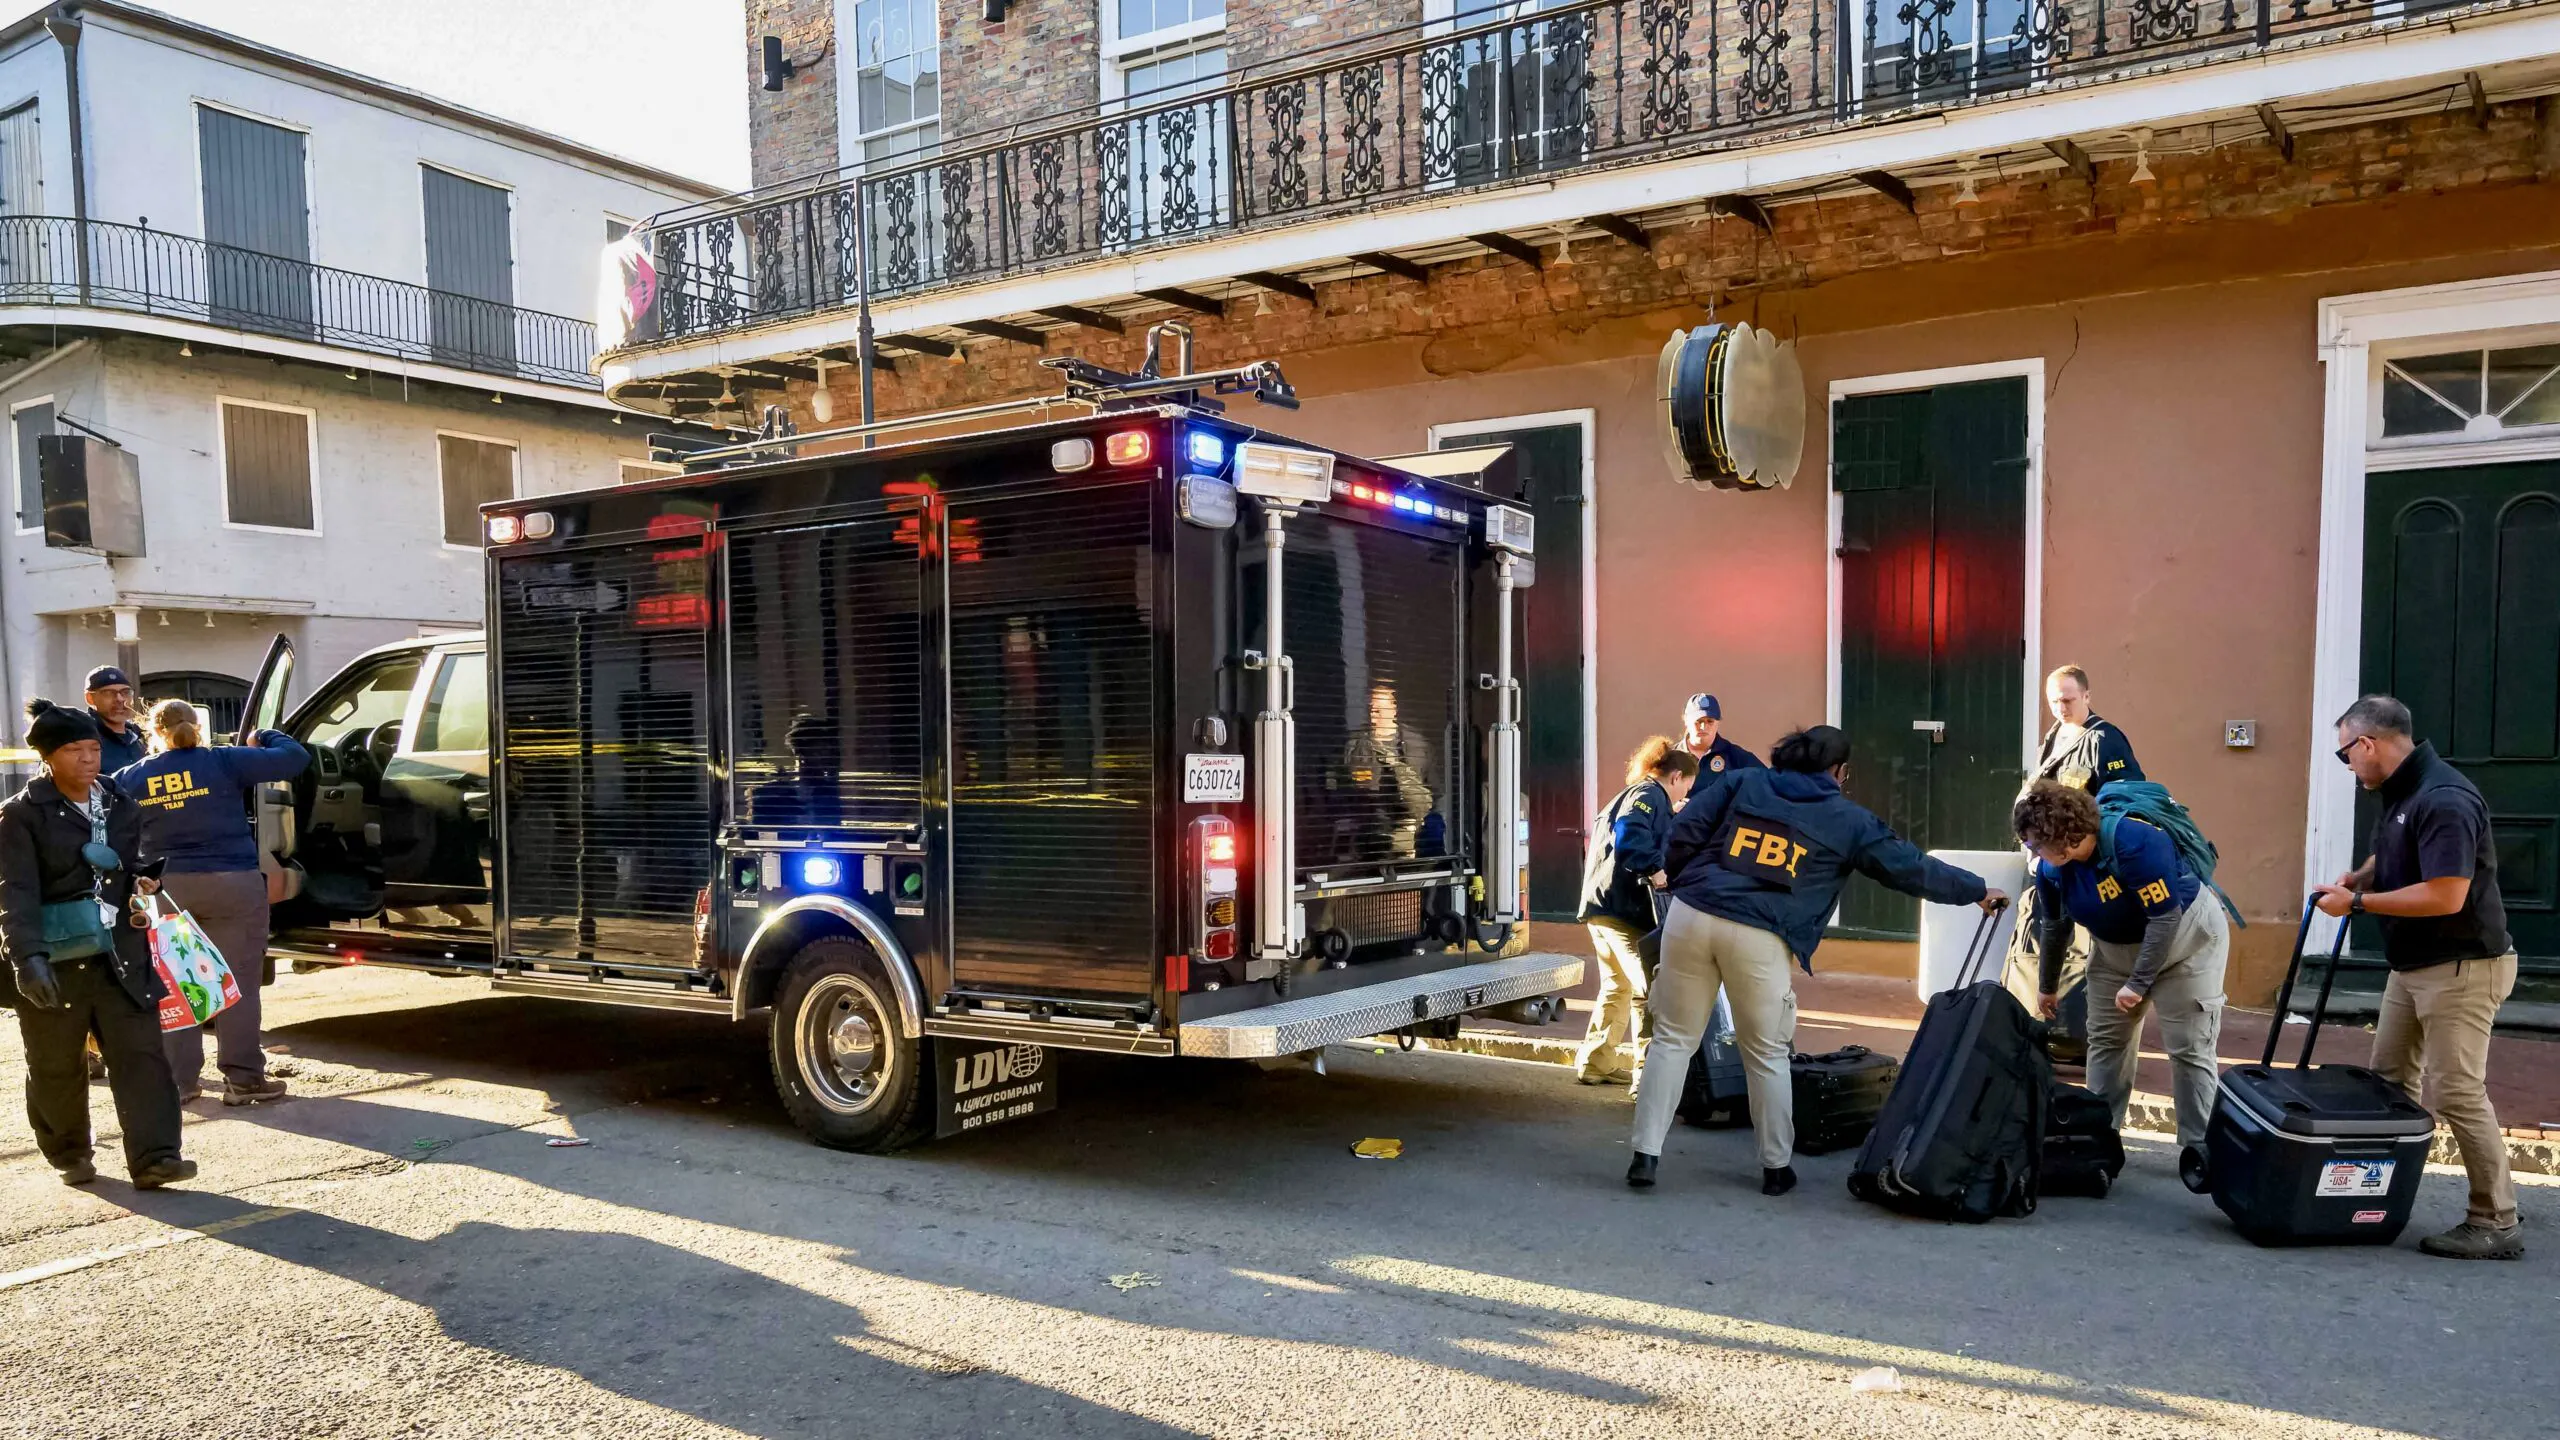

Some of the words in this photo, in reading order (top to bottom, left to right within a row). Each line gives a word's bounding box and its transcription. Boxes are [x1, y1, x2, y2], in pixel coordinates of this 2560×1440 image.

[2107, 760, 2125, 771] FBI
[147, 770, 193, 797] FBI
[1189, 769, 1241, 790] C630724
[172, 787, 209, 801] RESPONSE
[163, 800, 185, 811] TEAM
[1633, 800, 1652, 814] FBI
[1729, 826, 1808, 879] FBI
[2096, 875, 2123, 904] FBI
[2137, 878, 2170, 908] FBI
[954, 1046, 1017, 1094] LDV
[954, 1102, 962, 1114] A
[993, 1081, 1044, 1103] COMPANY
[963, 1114, 982, 1130] 800
[2332, 1176, 2349, 1186] USA
[2372, 1168, 2378, 1176] 5
